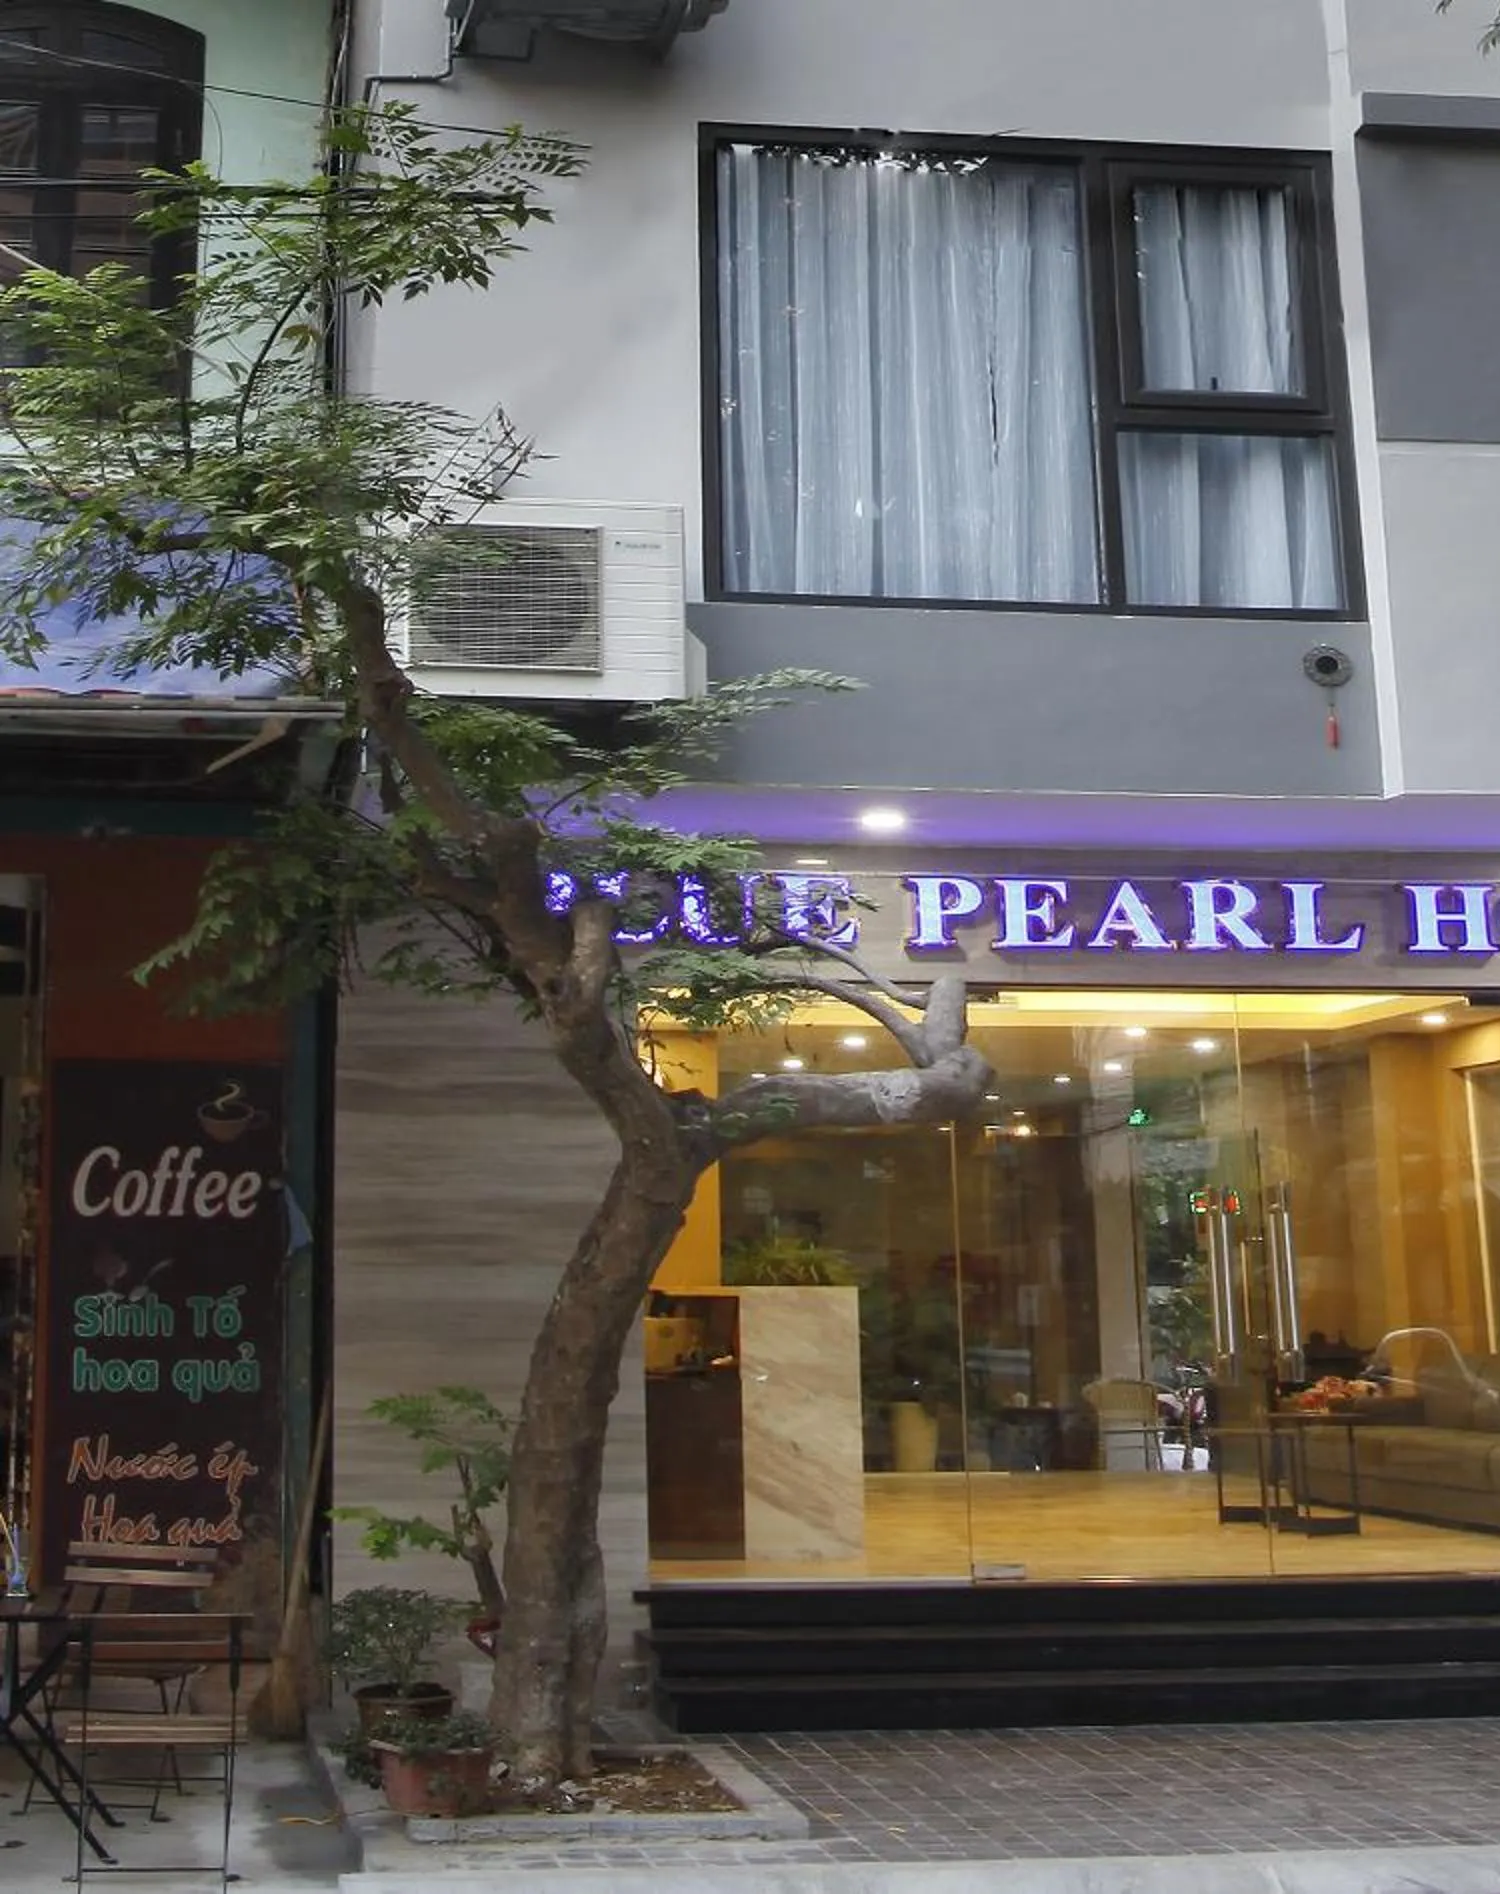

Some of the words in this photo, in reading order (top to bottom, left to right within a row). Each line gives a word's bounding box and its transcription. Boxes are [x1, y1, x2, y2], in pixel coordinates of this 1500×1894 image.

[903, 875, 1364, 954] PEARL
[73, 1146, 262, 1219] Coffee
[74, 1292, 176, 1339] Sinh
[186, 1284, 247, 1339] Tố
[73, 1346, 160, 1393] hoa
[172, 1342, 261, 1403] quả
[67, 1433, 200, 1484] Nước
[207, 1440, 259, 1496] ép
[81, 1493, 161, 1543] Hoa
